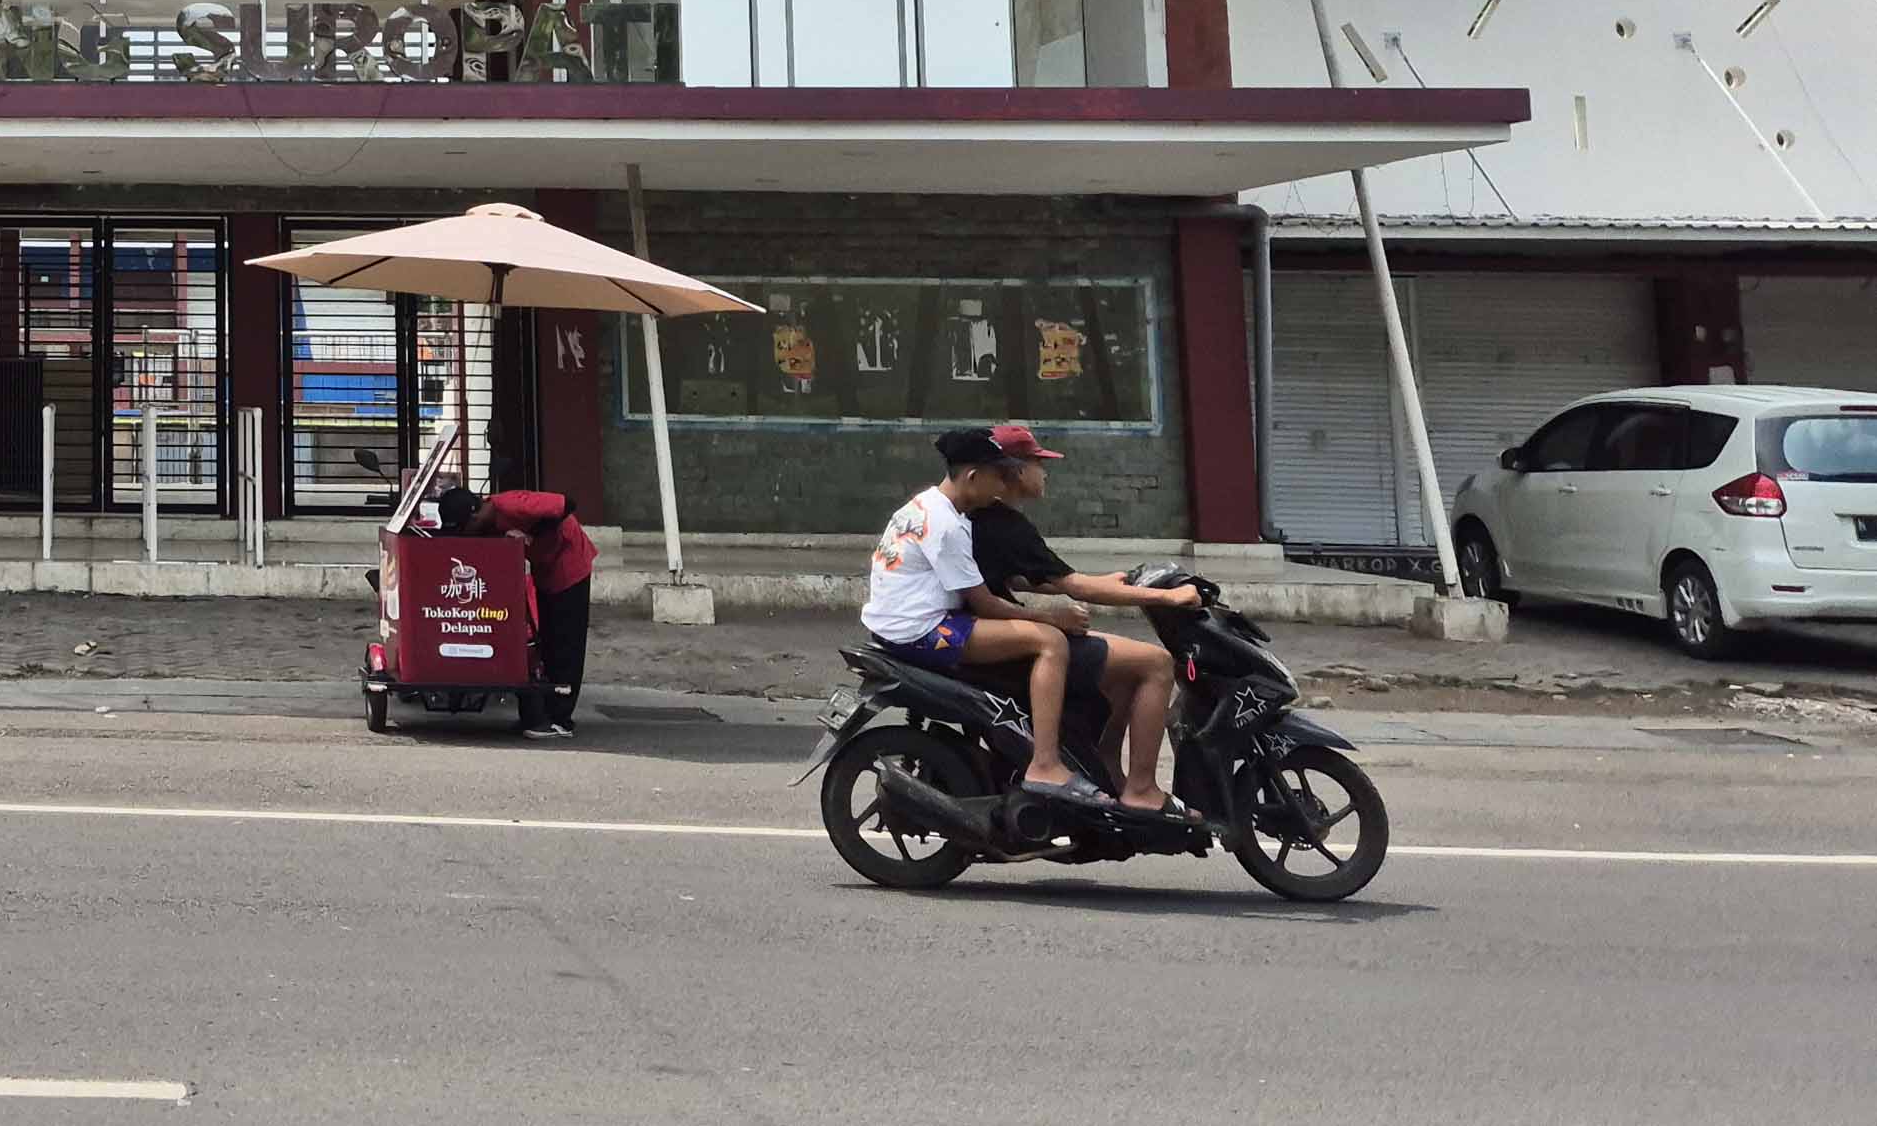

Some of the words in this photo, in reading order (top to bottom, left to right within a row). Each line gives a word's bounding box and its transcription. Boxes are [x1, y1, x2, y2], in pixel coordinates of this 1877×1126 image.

[172, 2, 683, 83] SUROPATI
[422, 606, 509, 622] TokoKop(ling)
[441, 621, 493, 636] Delapan
